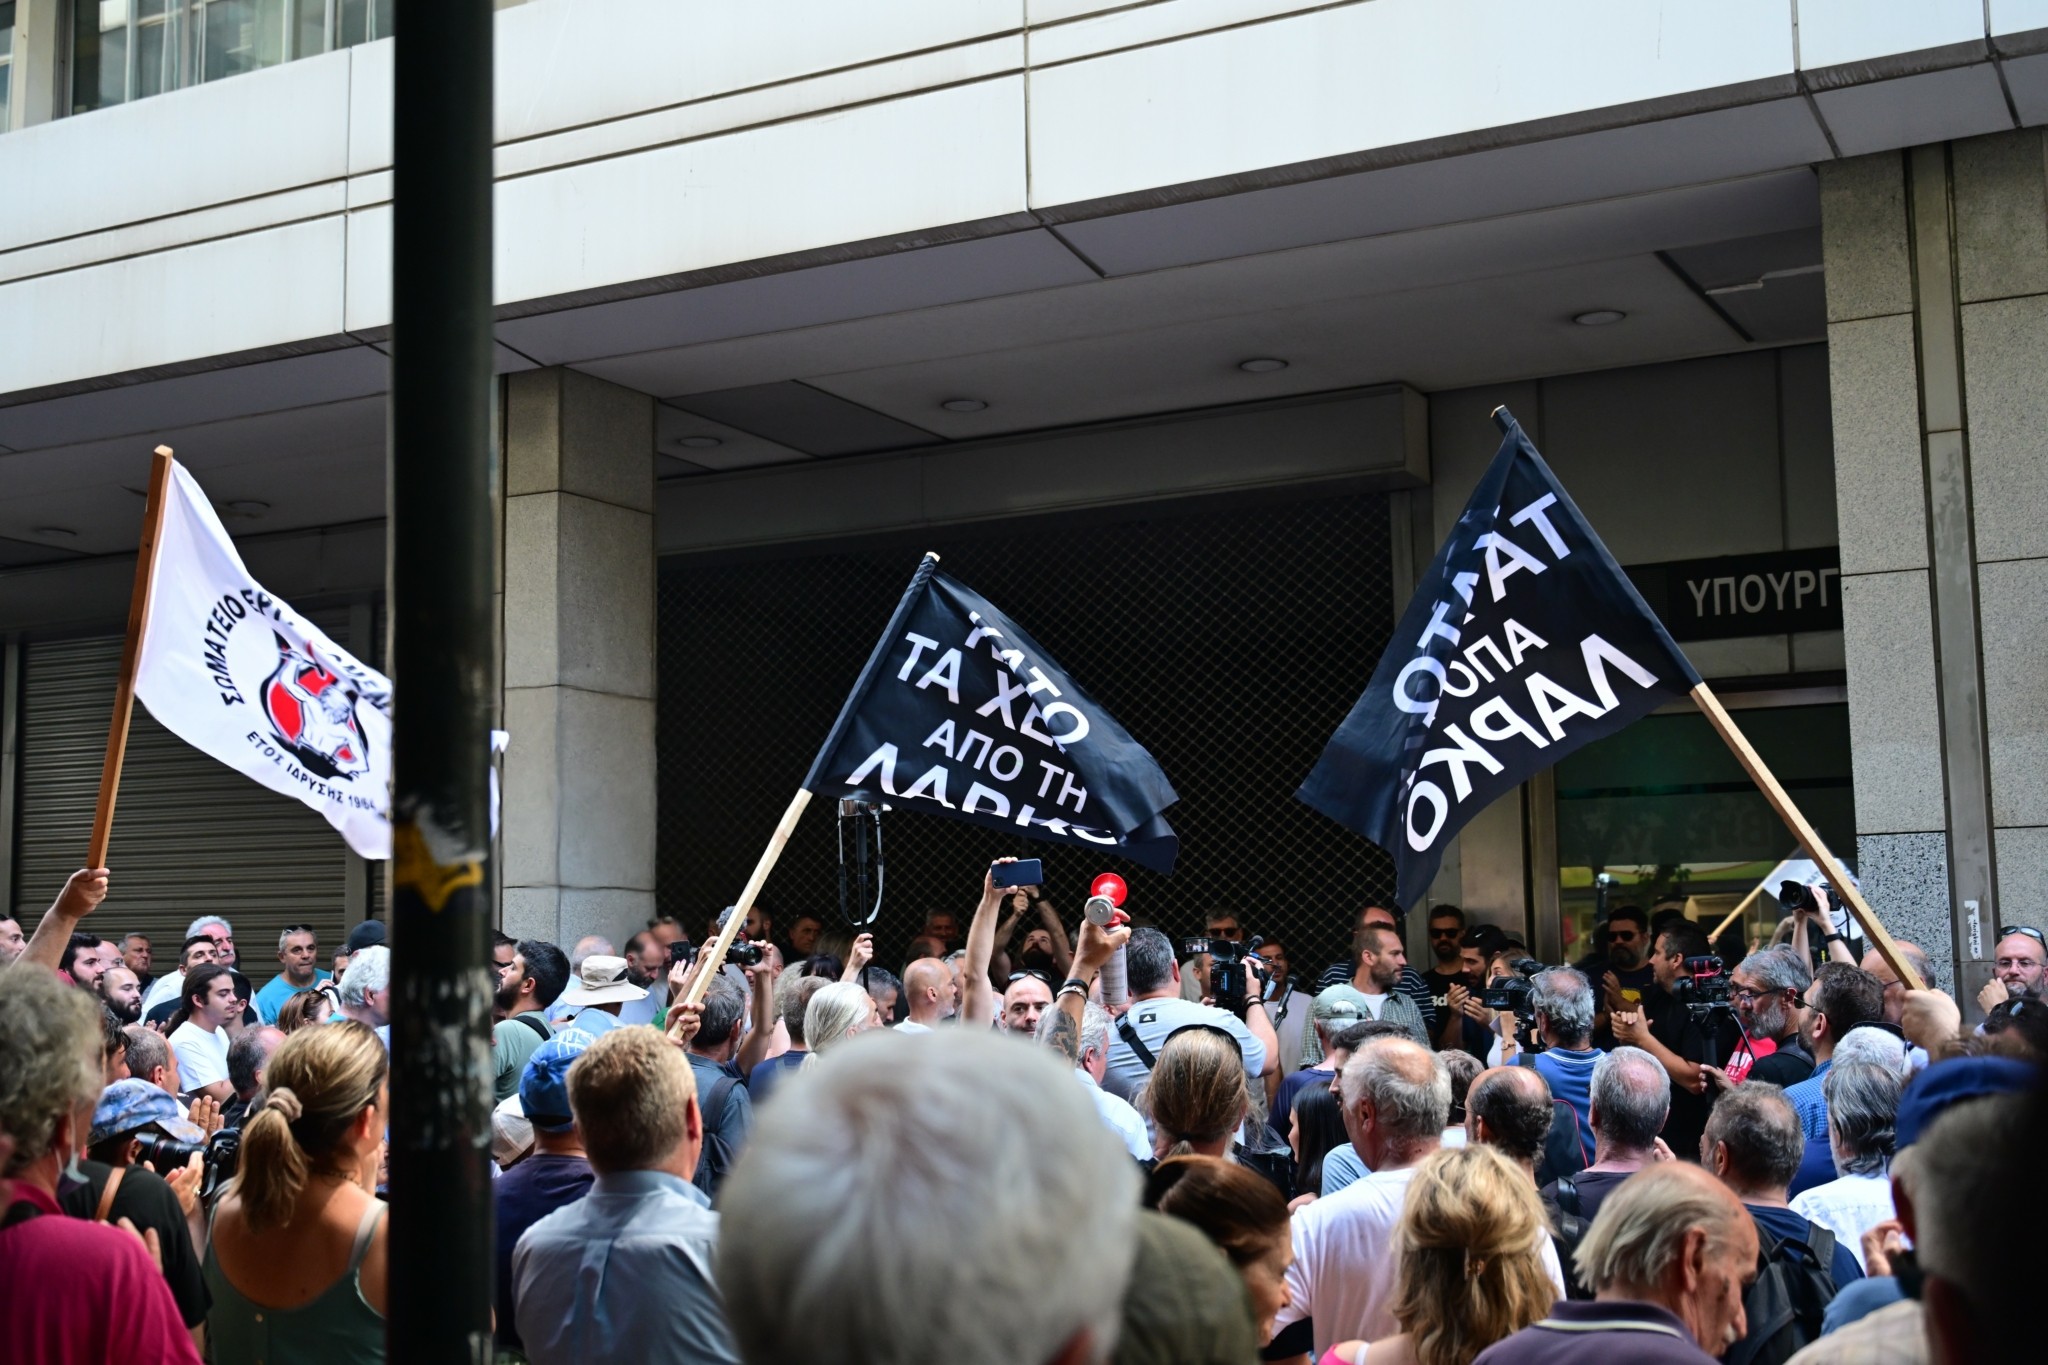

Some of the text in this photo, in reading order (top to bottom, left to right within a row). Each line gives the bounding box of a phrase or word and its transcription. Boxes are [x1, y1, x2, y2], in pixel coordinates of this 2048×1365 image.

[1686, 568, 1839, 617] ΥΠΟΥΡΓ
[203, 594, 246, 706] ΣΩΜΑΤΕΙΟ
[897, 631, 962, 704] ΤΑ
[246, 731, 284, 766] ΕΤΟΣ
[286, 763, 344, 803] ΙΔΡΥΣΗΣ
[922, 718, 1024, 782] ΑΠΟ
